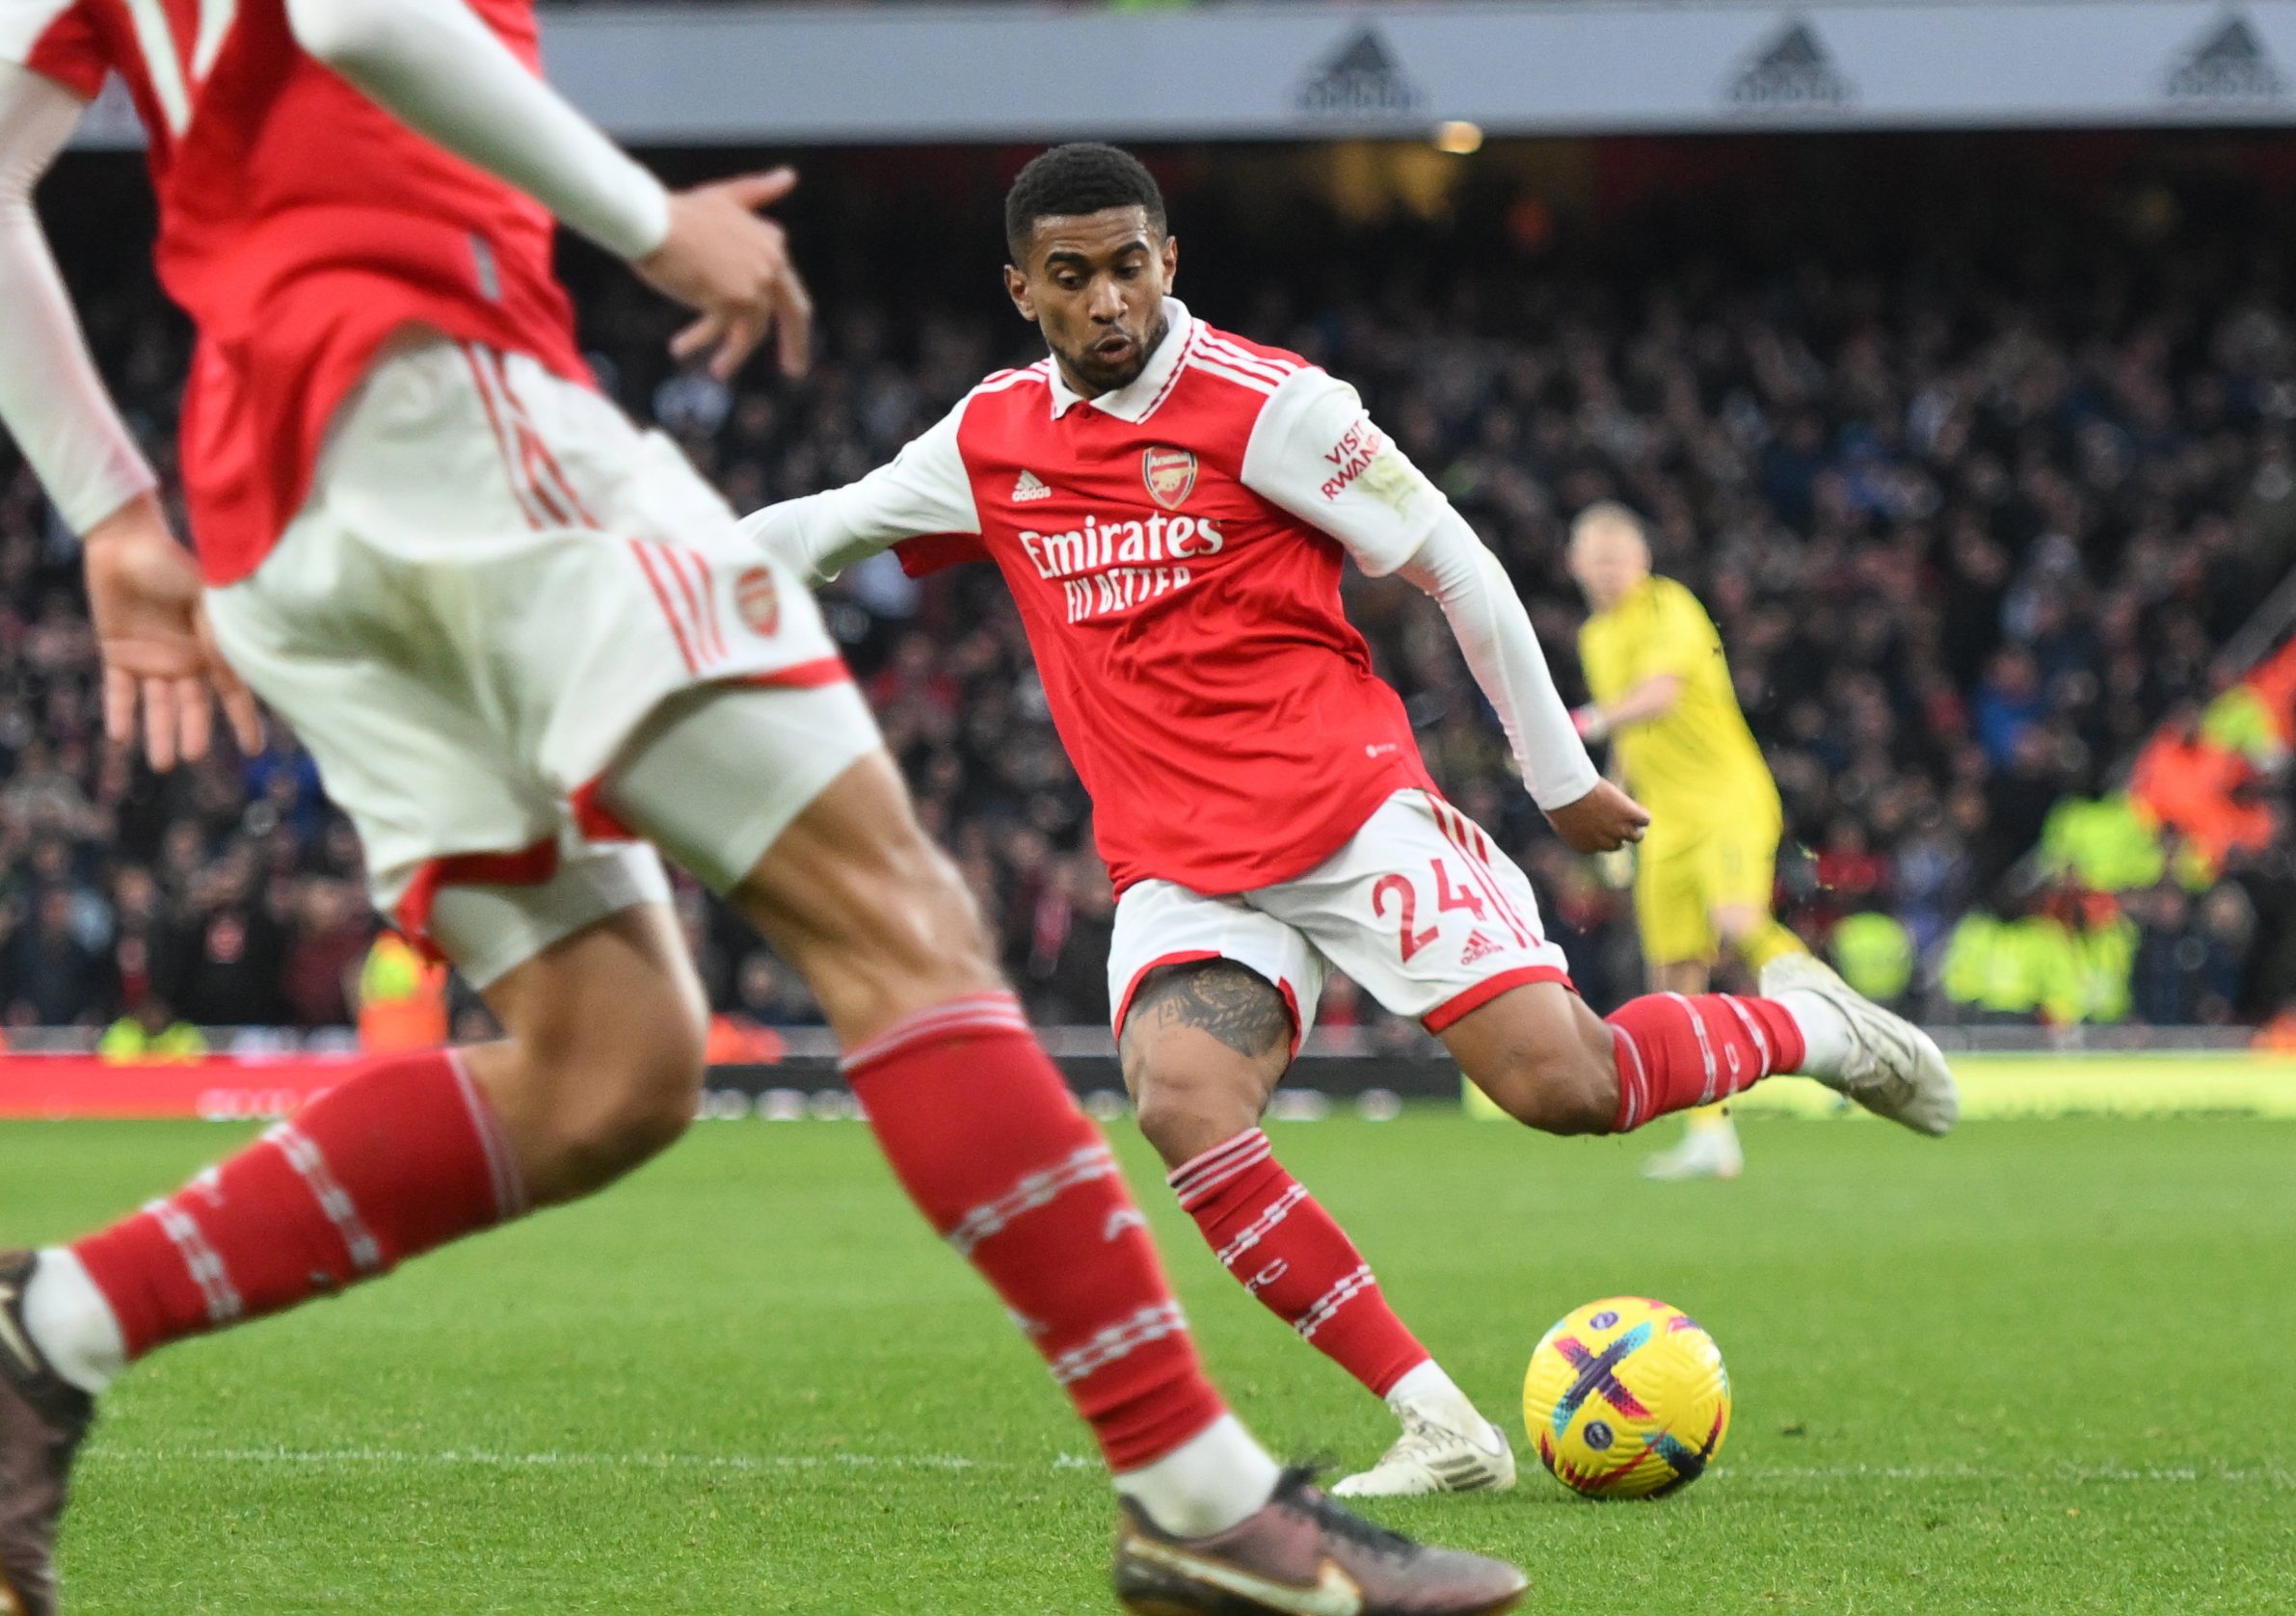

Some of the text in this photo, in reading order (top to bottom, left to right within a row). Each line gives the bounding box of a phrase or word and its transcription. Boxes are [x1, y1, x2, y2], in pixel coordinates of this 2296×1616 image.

[1324, 420, 1364, 464] VISIT
[1012, 486, 1052, 502] adidas
[1019, 511, 1223, 579] Emirates
[1373, 858, 1487, 964] 24
